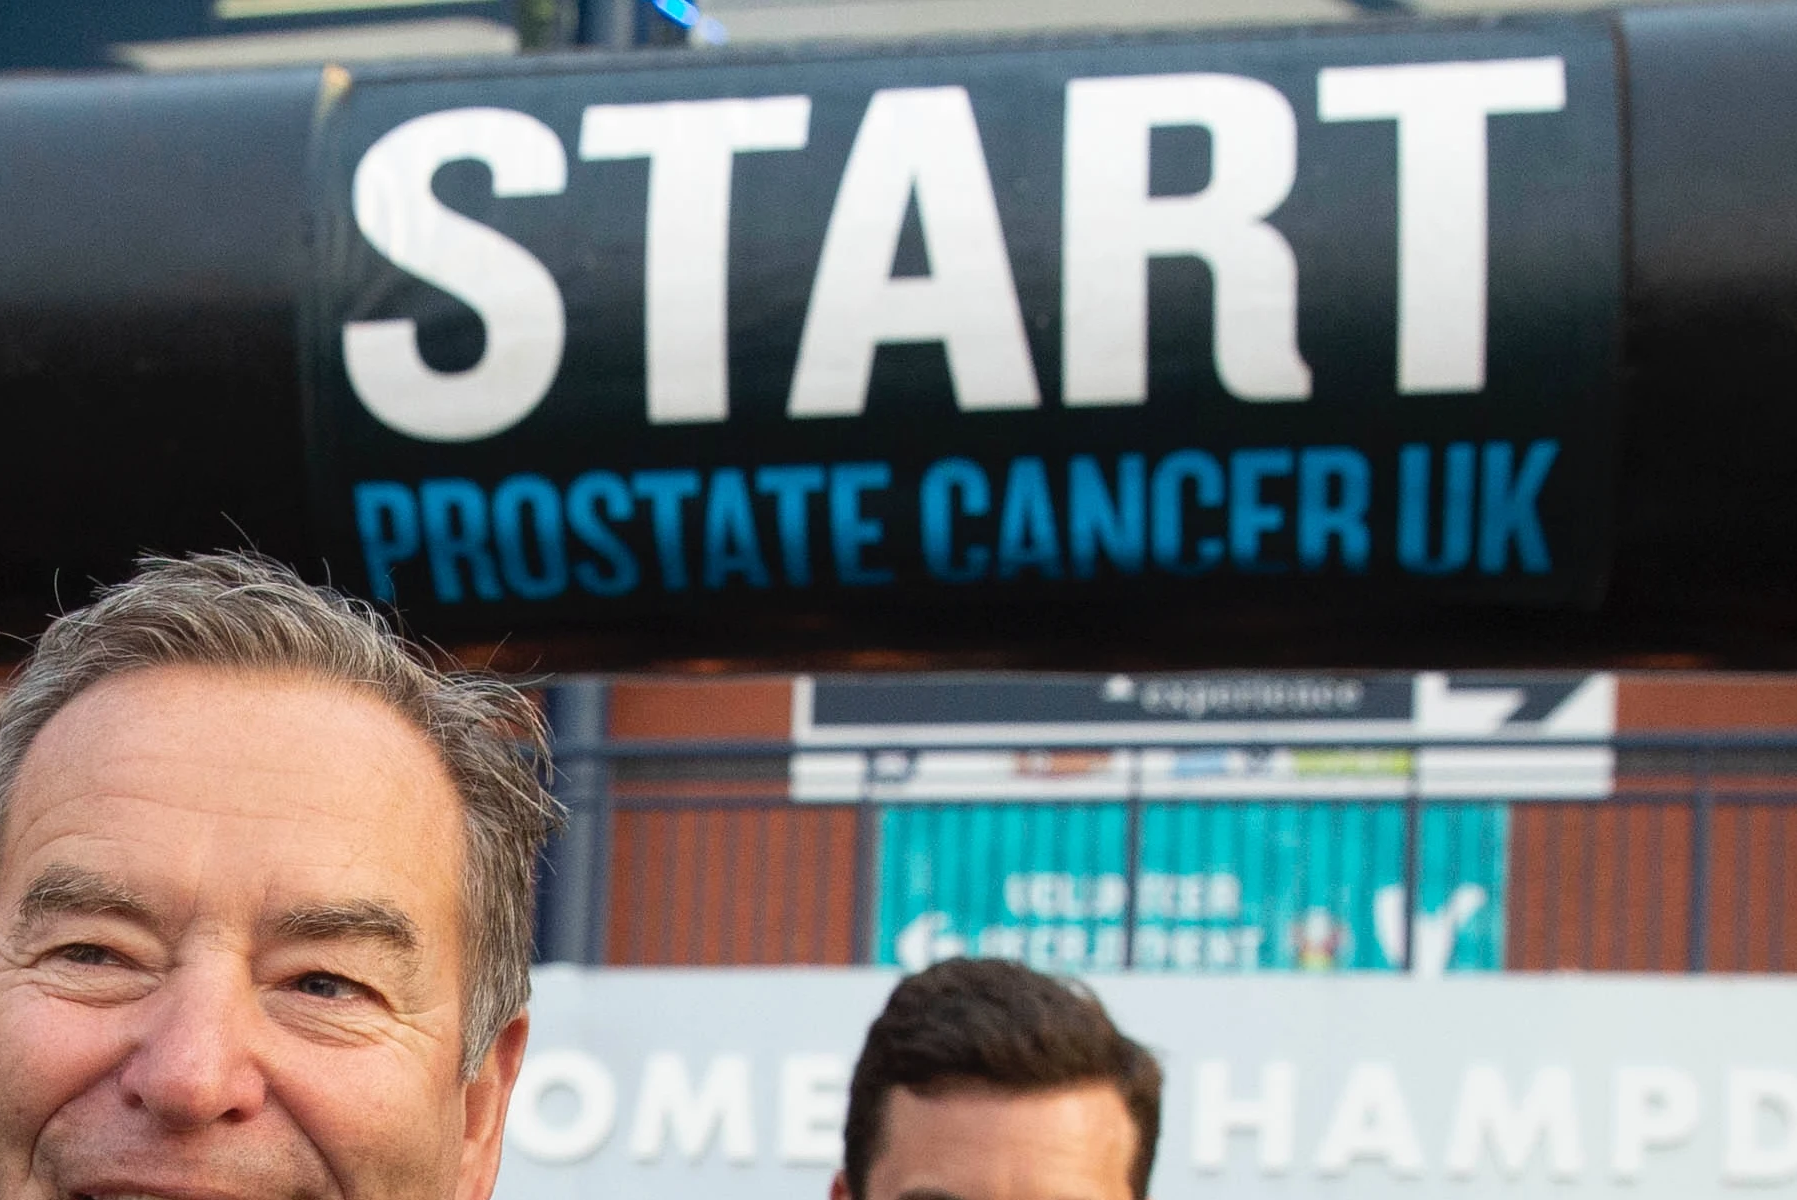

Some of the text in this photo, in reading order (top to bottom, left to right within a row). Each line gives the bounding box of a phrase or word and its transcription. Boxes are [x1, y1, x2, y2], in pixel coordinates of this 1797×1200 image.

[341, 55, 1567, 443] START
[353, 439, 1561, 601] PROSTATE CANCER UK
